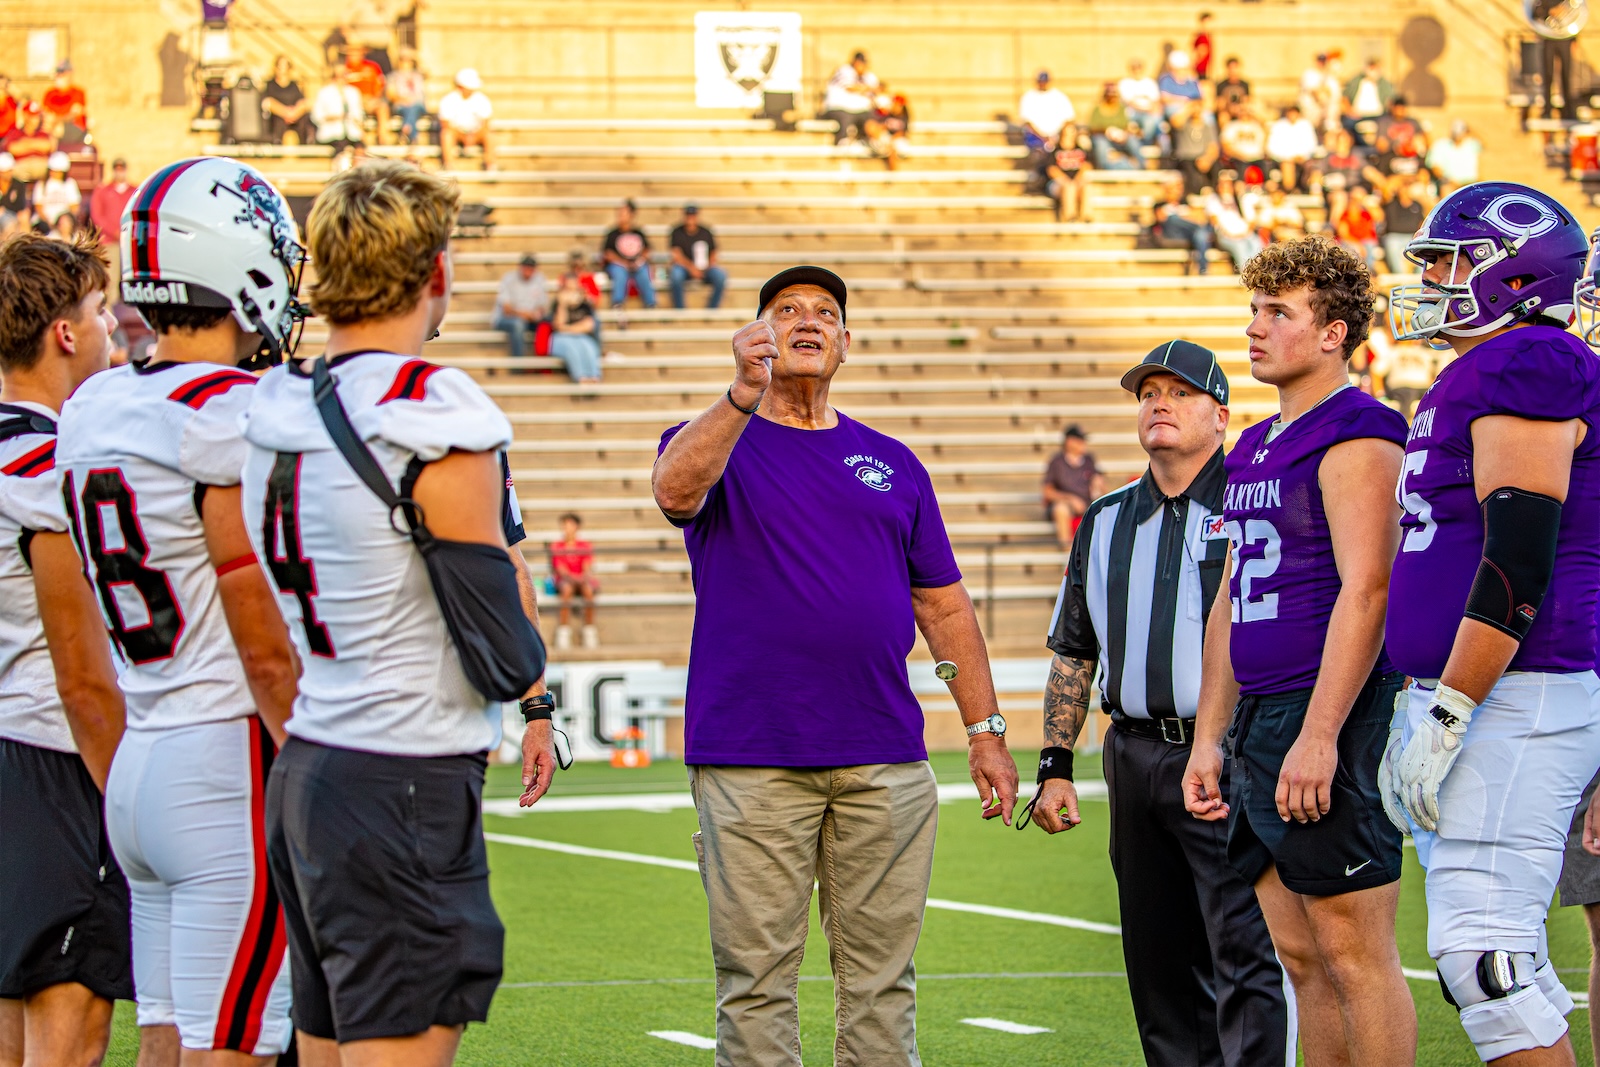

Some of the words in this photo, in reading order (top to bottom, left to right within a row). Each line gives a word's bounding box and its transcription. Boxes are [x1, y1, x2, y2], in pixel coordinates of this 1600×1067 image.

[843, 454, 865, 467] Class
[864, 455, 873, 464] of
[874, 459, 895, 476] 1976
[263, 449, 336, 659] 4
[1429, 704, 1460, 728] NIKE
